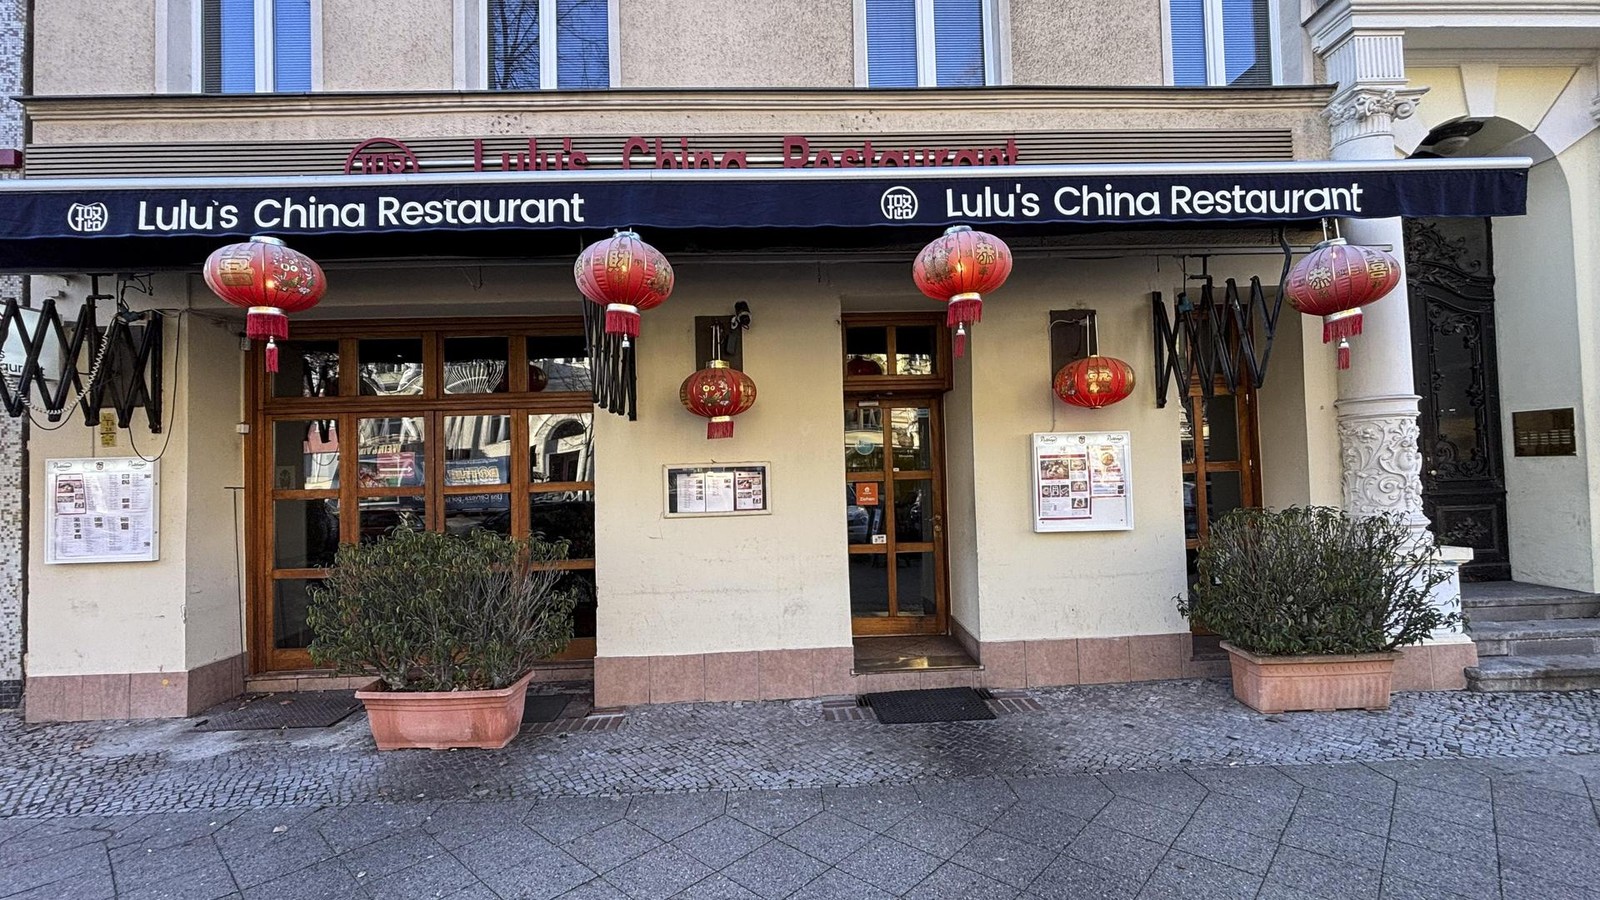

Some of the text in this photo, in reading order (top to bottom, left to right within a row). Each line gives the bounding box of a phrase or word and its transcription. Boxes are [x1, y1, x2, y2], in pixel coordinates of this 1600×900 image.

[138, 192, 585, 231] Lulu's China Restaurant
[946, 182, 1364, 218] Lulu's China Restaurant
